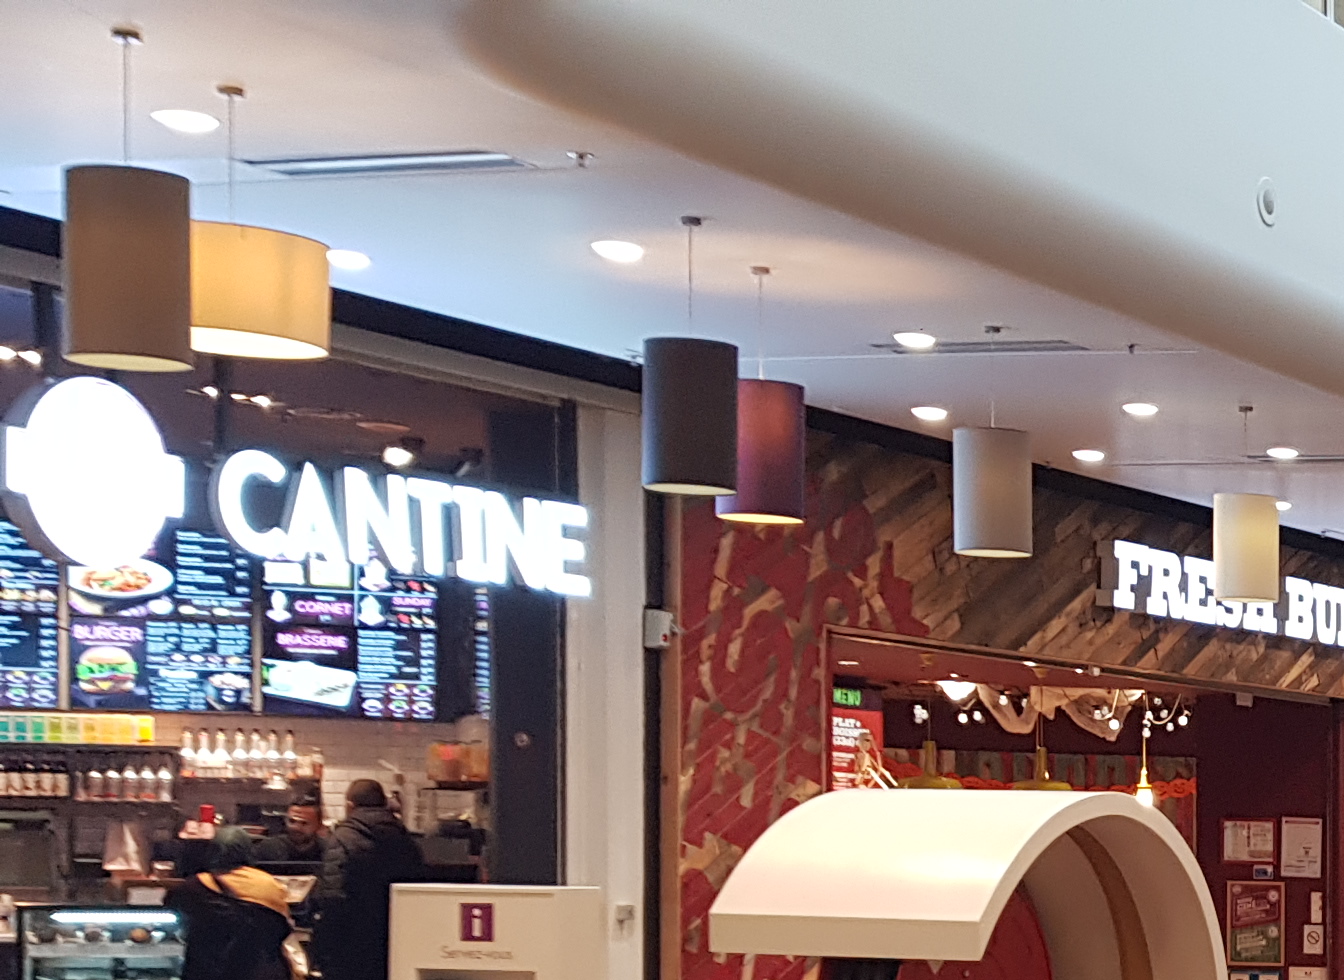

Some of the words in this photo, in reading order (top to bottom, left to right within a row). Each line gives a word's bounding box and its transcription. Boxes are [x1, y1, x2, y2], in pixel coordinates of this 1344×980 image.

[217, 449, 593, 598] CANTINE
[294, 600, 352, 616] CORNET
[71, 623, 144, 643] BURGER
[276, 633, 348, 649] BRASSERIE
